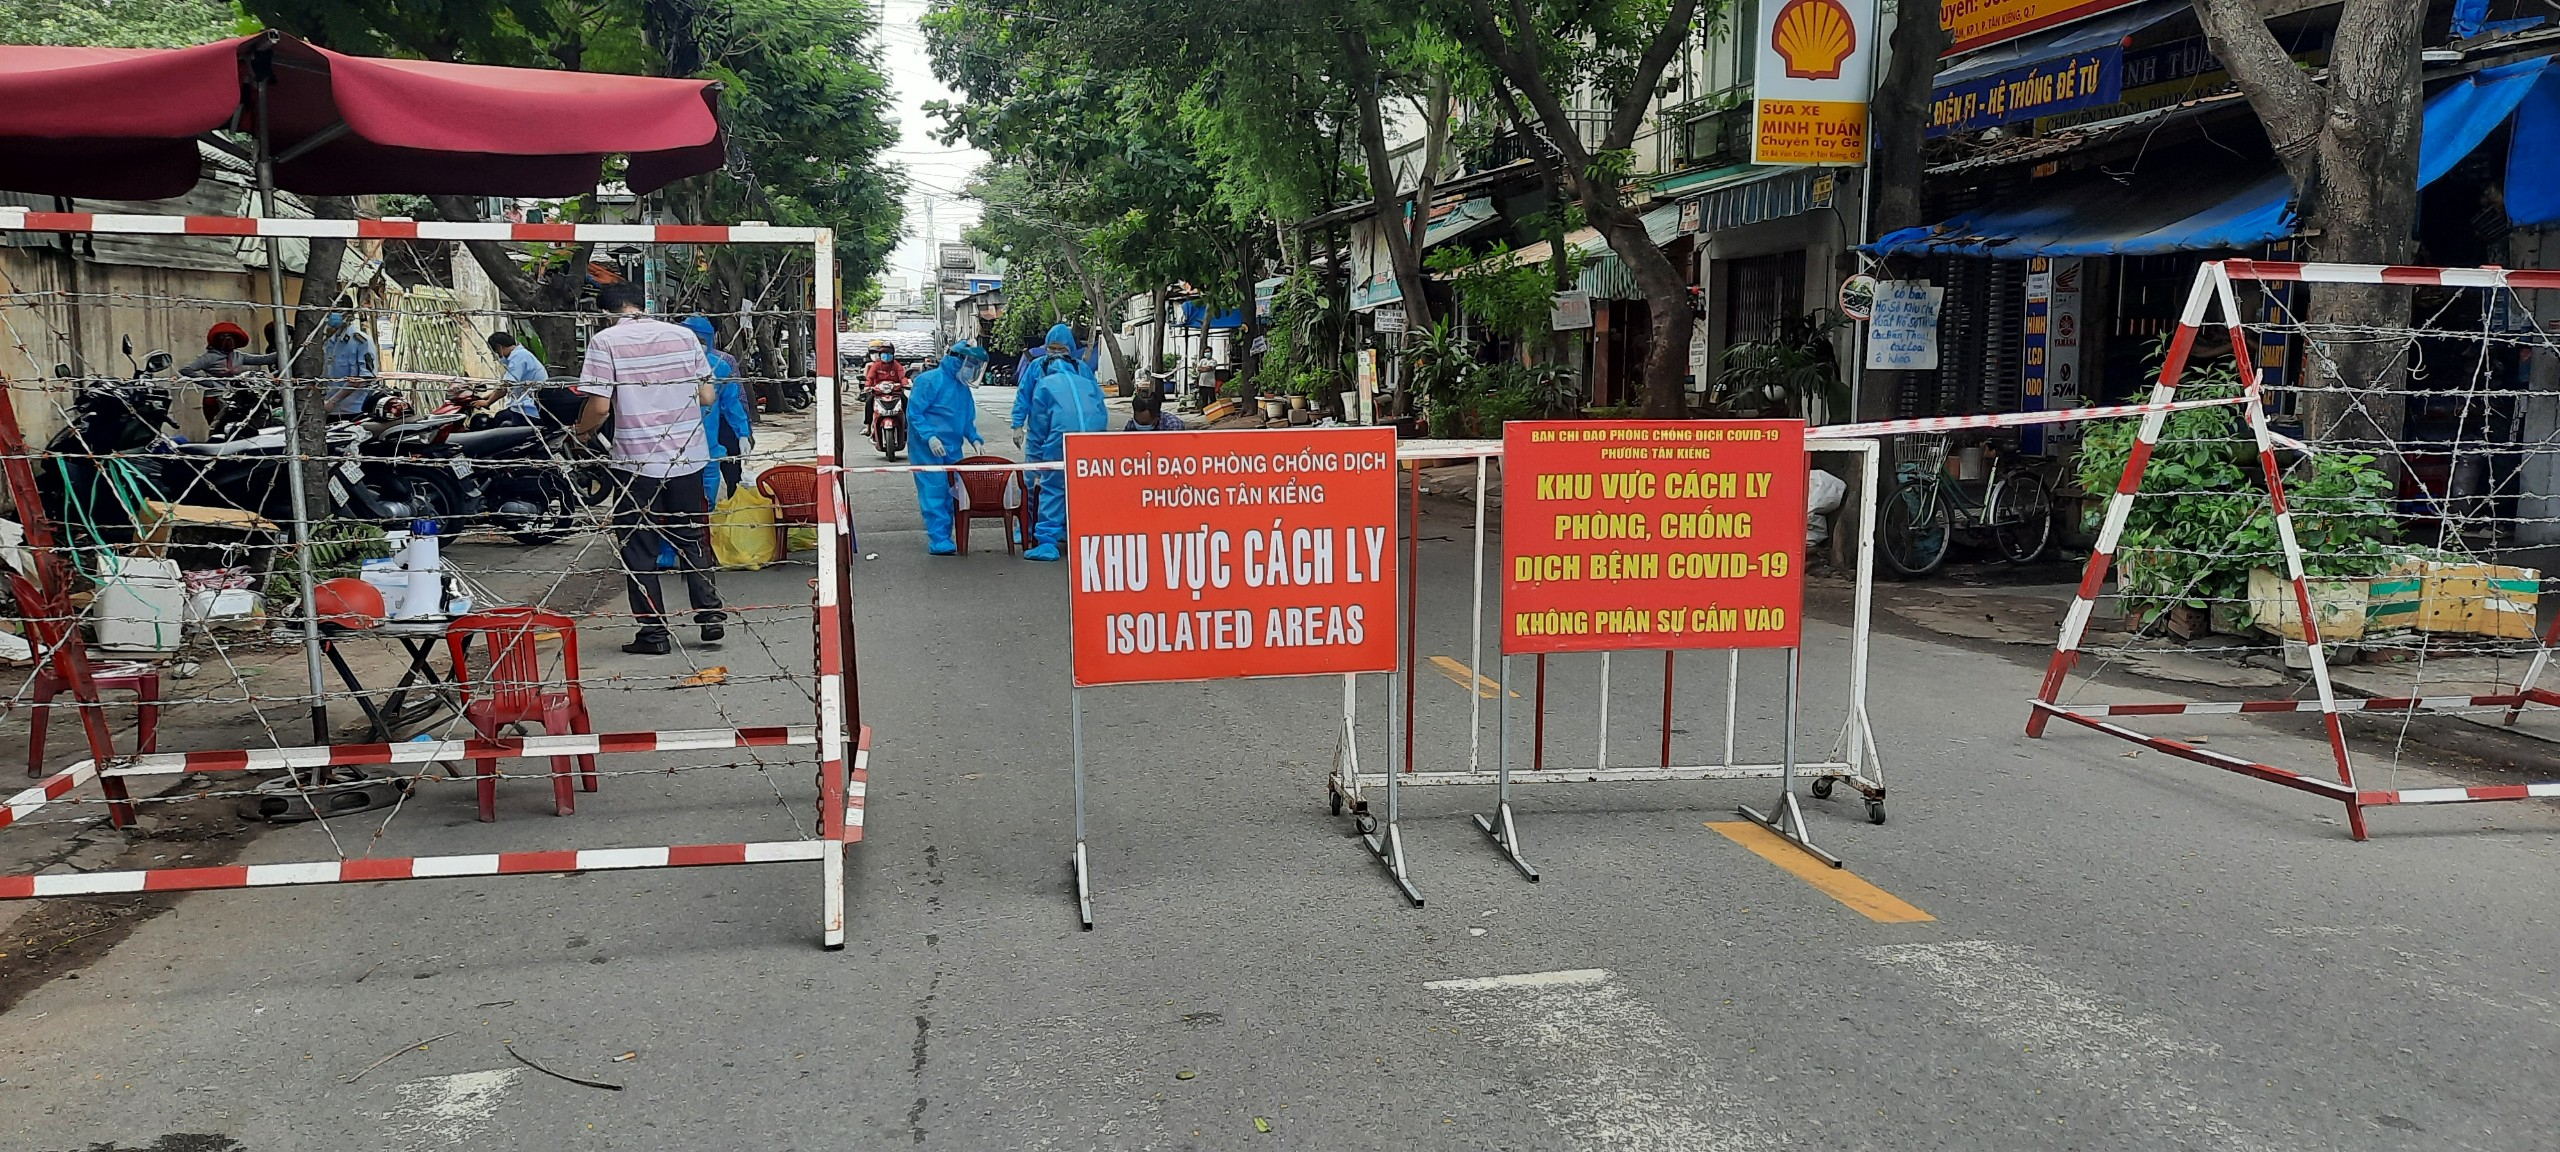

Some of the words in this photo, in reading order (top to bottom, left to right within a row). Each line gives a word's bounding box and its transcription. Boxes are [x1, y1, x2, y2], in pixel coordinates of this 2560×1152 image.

[1933, 91, 1961, 130] ĐIỆN
[1987, 80, 2006, 119] HỆ
[2009, 67, 2052, 110] THỐNG
[2056, 59, 2078, 101] ĐỀ
[2079, 57, 2100, 97] TỪ
[1763, 101, 1795, 115] SỬA
[1801, 105, 1820, 116] XE
[1762, 121, 1809, 134] MINH
[1815, 117, 1861, 136] TUẤN
[1761, 136, 1809, 148] Chuyên
[1814, 137, 1837, 149] Tay
[1841, 138, 1860, 148] Ga
[2027, 311, 2046, 334] HÌNH
[2027, 347, 2043, 365] LCD
[2026, 378, 2042, 396] ODO
[2052, 383, 2077, 398] SYM
[1531, 429, 1555, 442] BAN
[1610, 427, 1648, 441] PHÒNG
[1652, 426, 1692, 441] CHỐNG
[1726, 428, 1779, 441] COVID-19
[1077, 458, 1114, 477] BAN
[1120, 452, 1152, 476] CHỈ
[1157, 456, 1197, 478] ĐẠO
[1202, 451, 1267, 475] PHÒNG
[1272, 446, 1338, 473] CHỐNG
[1344, 452, 1387, 474] DỊCH
[1651, 446, 1673, 459] TÂN
[1142, 484, 1220, 508] PHƯỜNG
[1226, 482, 1262, 505] TÂN
[1268, 477, 1325, 505] KIỂNG
[1537, 473, 1593, 501] KHU
[1600, 470, 1656, 503] VỰC
[1664, 470, 1738, 499] CÁCH
[1745, 472, 1773, 499] LY
[1555, 509, 1652, 542] PHÒNG,
[1660, 505, 1752, 539] CHỐNG
[1080, 533, 1149, 593] KHU
[1161, 523, 1231, 601] VỰC
[1243, 518, 1334, 588] CÁCH
[1346, 526, 1386, 583] LY
[1515, 555, 1581, 587] DỊCH
[1589, 550, 1659, 584] BỆNH
[1667, 552, 1789, 581] COVID-19
[1106, 609, 1253, 655] ISOLATED
[1264, 604, 1364, 648] AREAS
[1516, 608, 1589, 636] KHÔNG
[1595, 606, 1651, 638] PHẬN
[1657, 606, 1688, 637] SỰ
[1691, 601, 1738, 633] CẤM
[1744, 605, 1785, 631] VÀO
